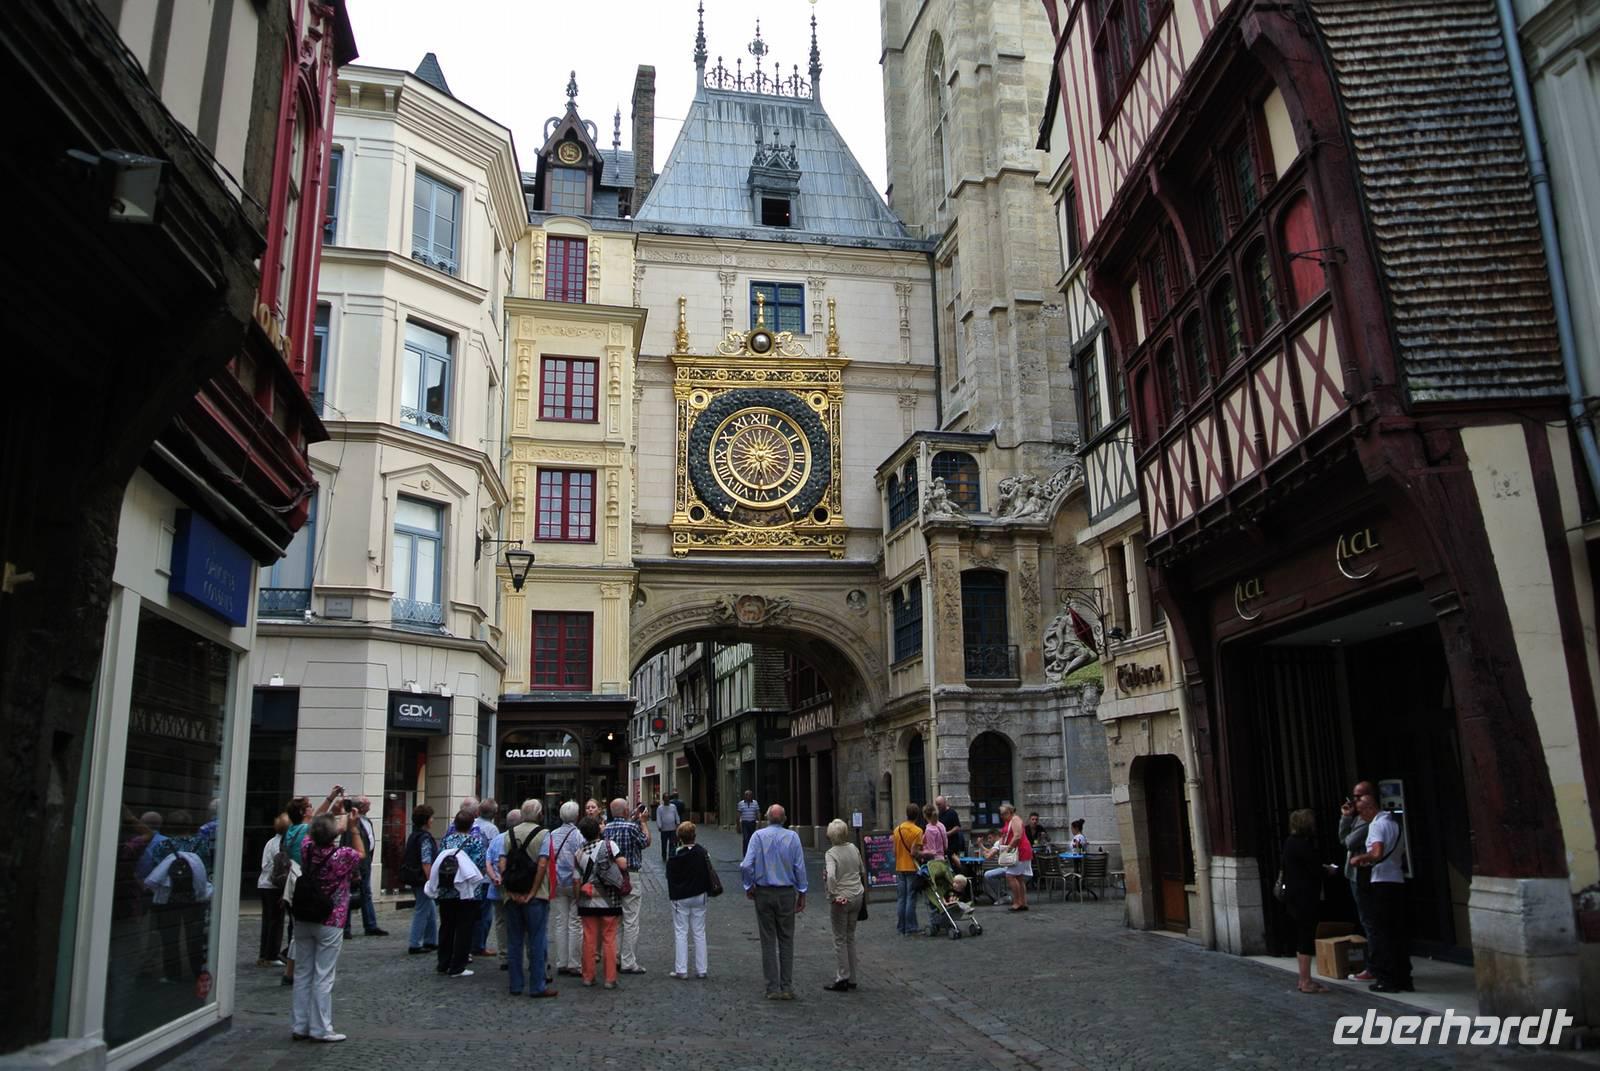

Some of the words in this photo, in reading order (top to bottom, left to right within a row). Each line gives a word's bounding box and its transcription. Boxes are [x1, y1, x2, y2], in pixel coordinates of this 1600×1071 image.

[731, 416, 749, 431] XI
[750, 413, 768, 425] XII
[775, 419, 783, 429] I
[719, 430, 733, 444] X
[787, 433, 799, 444] II
[715, 448, 727, 463] IX
[794, 452, 805, 463] III
[717, 465, 733, 487] VIII
[787, 468, 802, 486] IIII
[732, 482, 749, 498] VII
[754, 490, 770, 501] VI
[777, 486, 788, 497] V
[1340, 528, 1379, 560] LCL
[1236, 577, 1265, 604] LCL
[399, 704, 433, 718] GDM
[505, 749, 572, 758] CALZEDONIA
